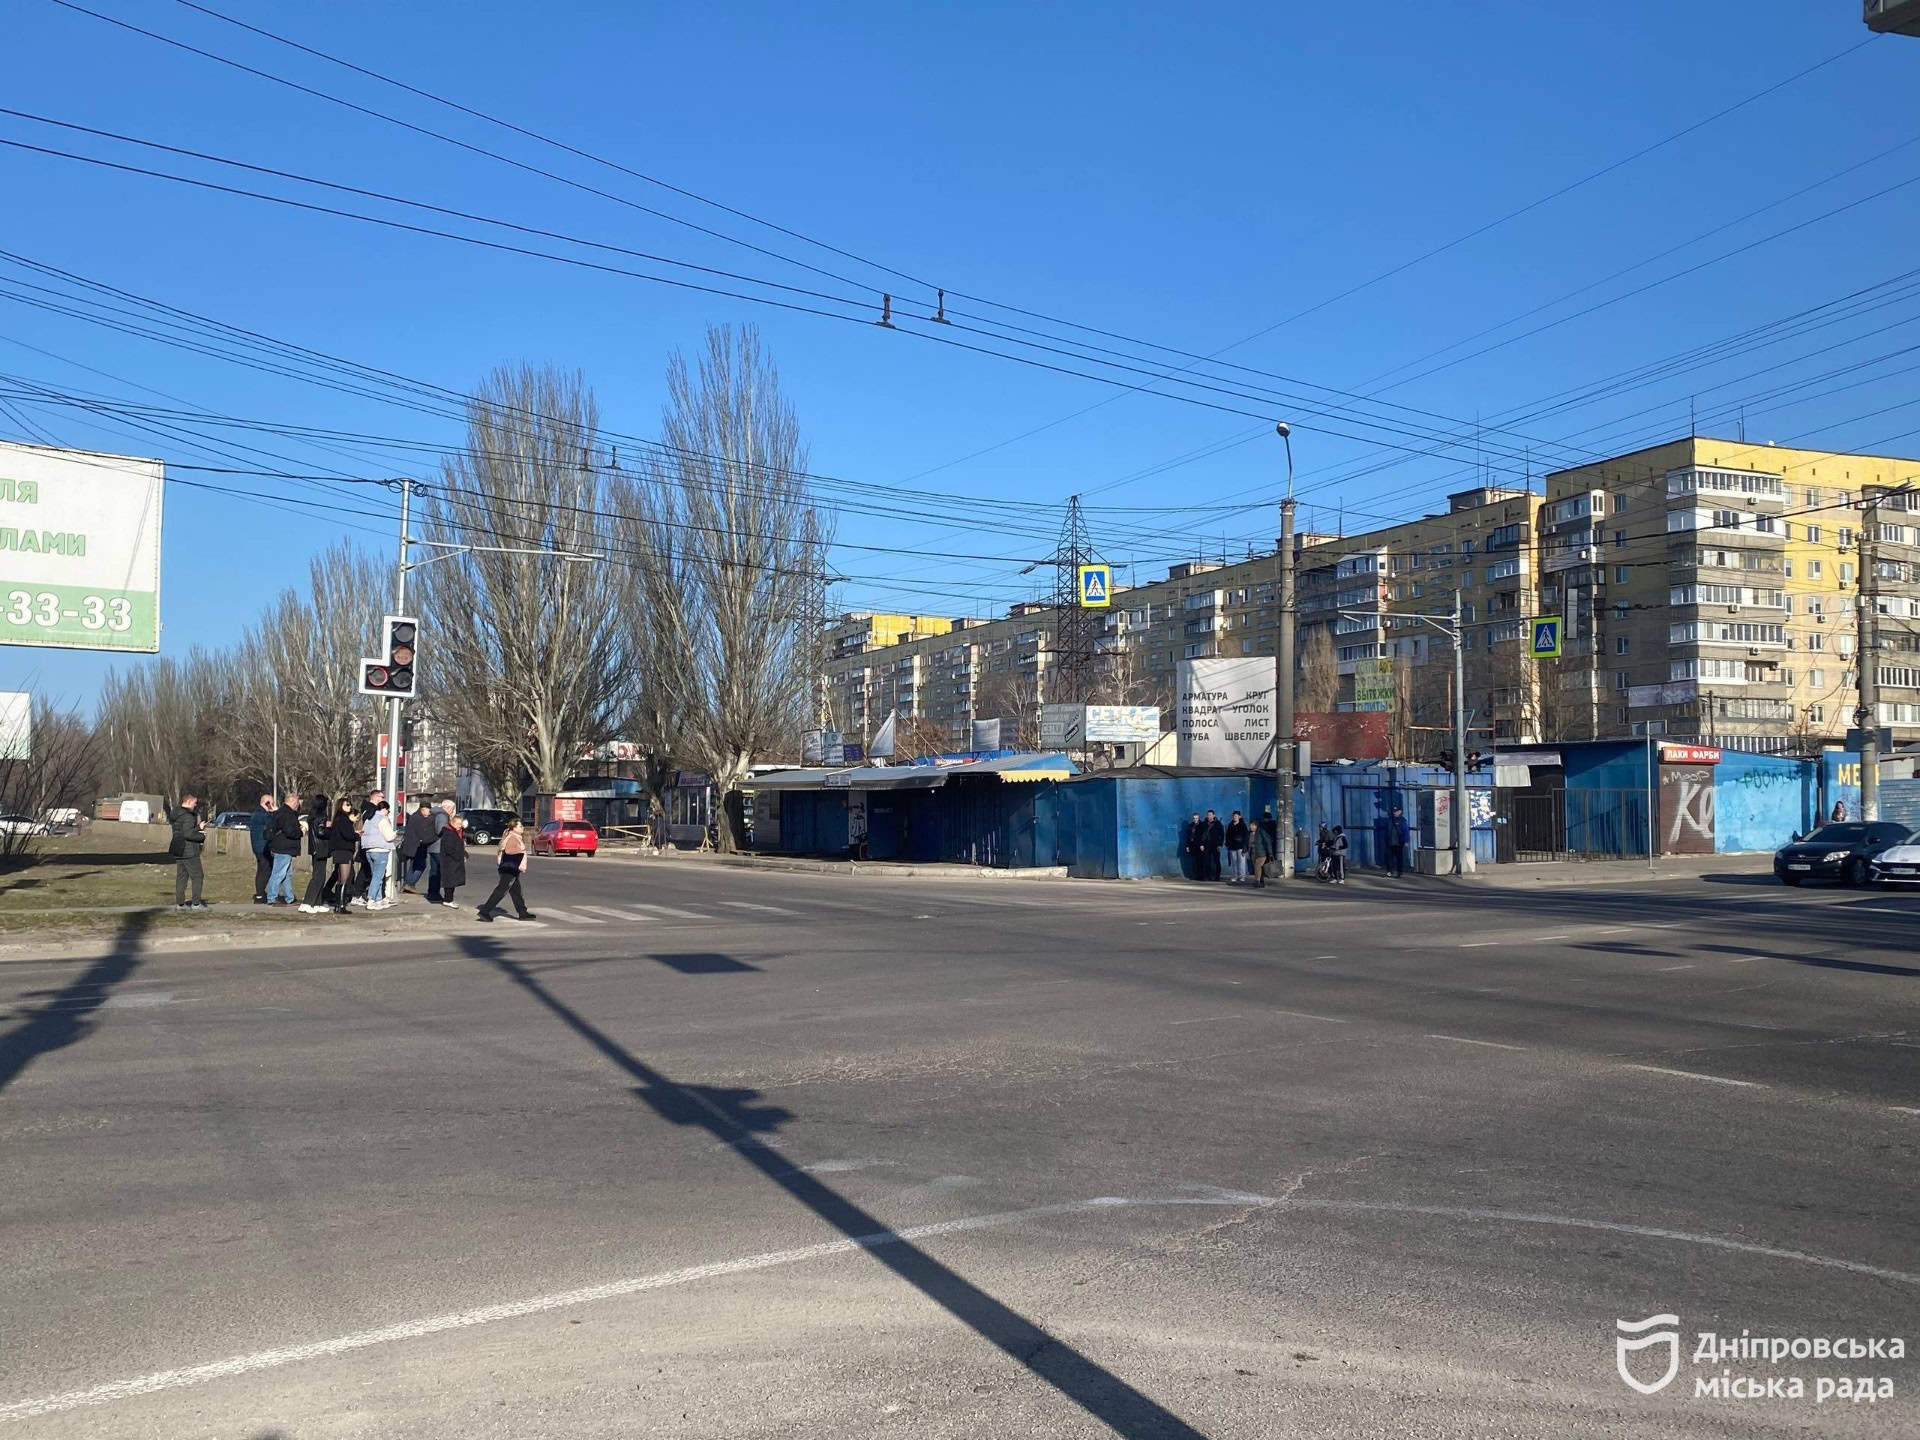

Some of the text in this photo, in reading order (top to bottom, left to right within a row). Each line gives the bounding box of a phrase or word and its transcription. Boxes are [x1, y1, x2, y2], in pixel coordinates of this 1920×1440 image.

[0, 590, 132, 632] 33-33
[1182, 691, 1269, 701] АРМАТУРА КРУГ
[1182, 704, 1269, 716] КВАДРАТ УГОЛОК
[1182, 718, 1270, 728] ПОЛОСА ЛИСТ
[1182, 732, 1271, 741] ТРУБА ШВЕЛЛЕР
[1692, 750, 1720, 760] ФАРБИ
